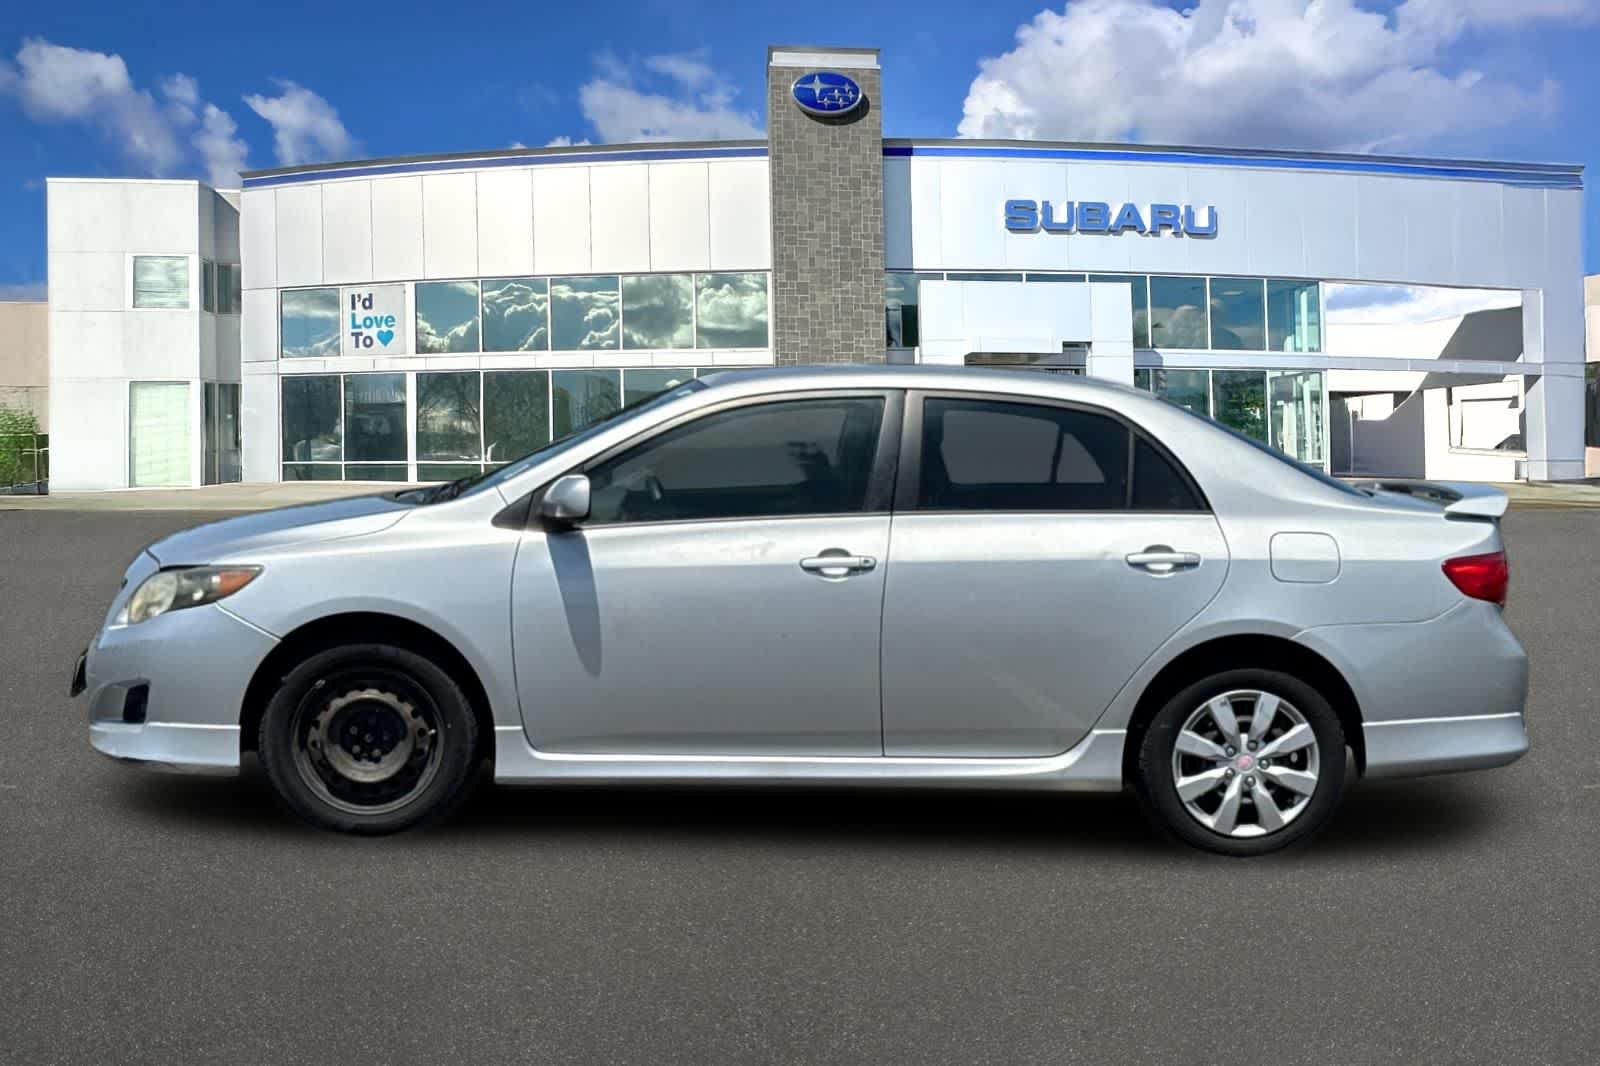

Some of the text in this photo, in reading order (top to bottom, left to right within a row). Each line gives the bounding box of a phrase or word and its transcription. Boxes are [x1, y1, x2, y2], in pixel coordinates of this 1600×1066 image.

[1005, 199, 1218, 238] SUBARU
[351, 293, 373, 311] I'd
[351, 312, 396, 329] Love
[351, 331, 374, 348] To
